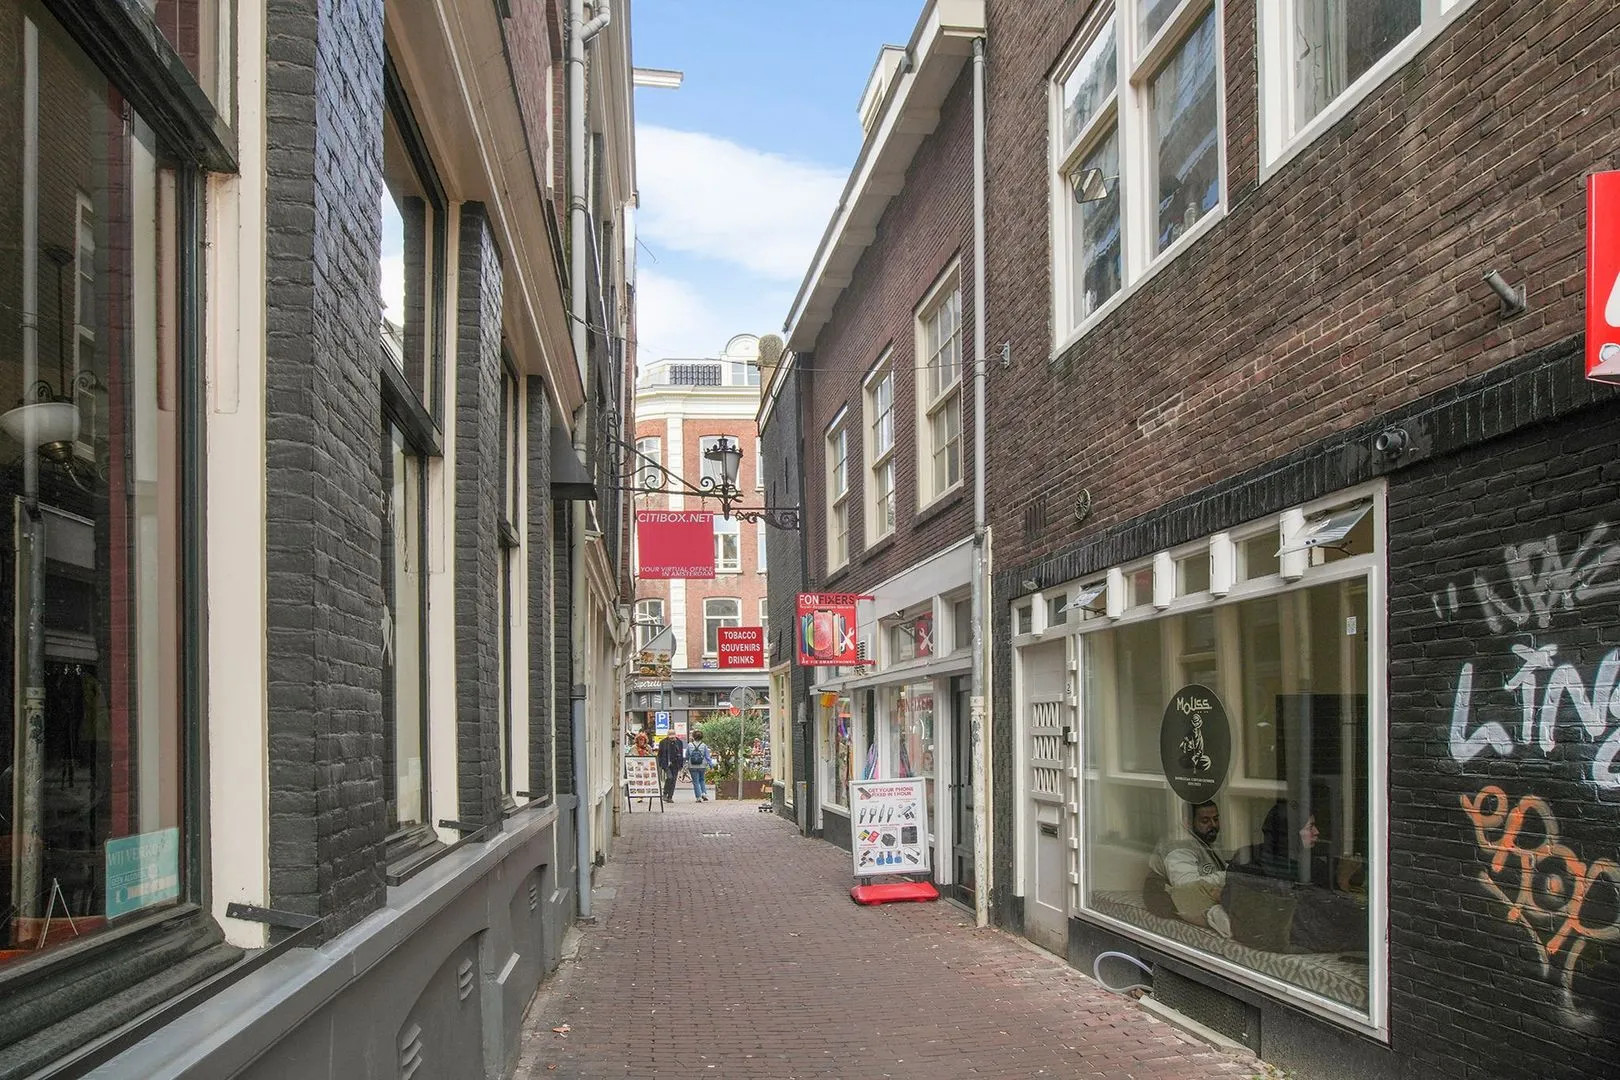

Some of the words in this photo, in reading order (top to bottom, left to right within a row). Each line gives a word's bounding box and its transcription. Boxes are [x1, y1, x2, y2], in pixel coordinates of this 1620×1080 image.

[638, 513, 713, 523] CITIBOX.NET
[800, 594, 855, 605] FONFIXERS
[724, 631, 757, 640] TOBACCO
[721, 643, 761, 652] SOUVENIRS
[728, 655, 755, 664] DRINKS
[658, 713, 666, 723] P
